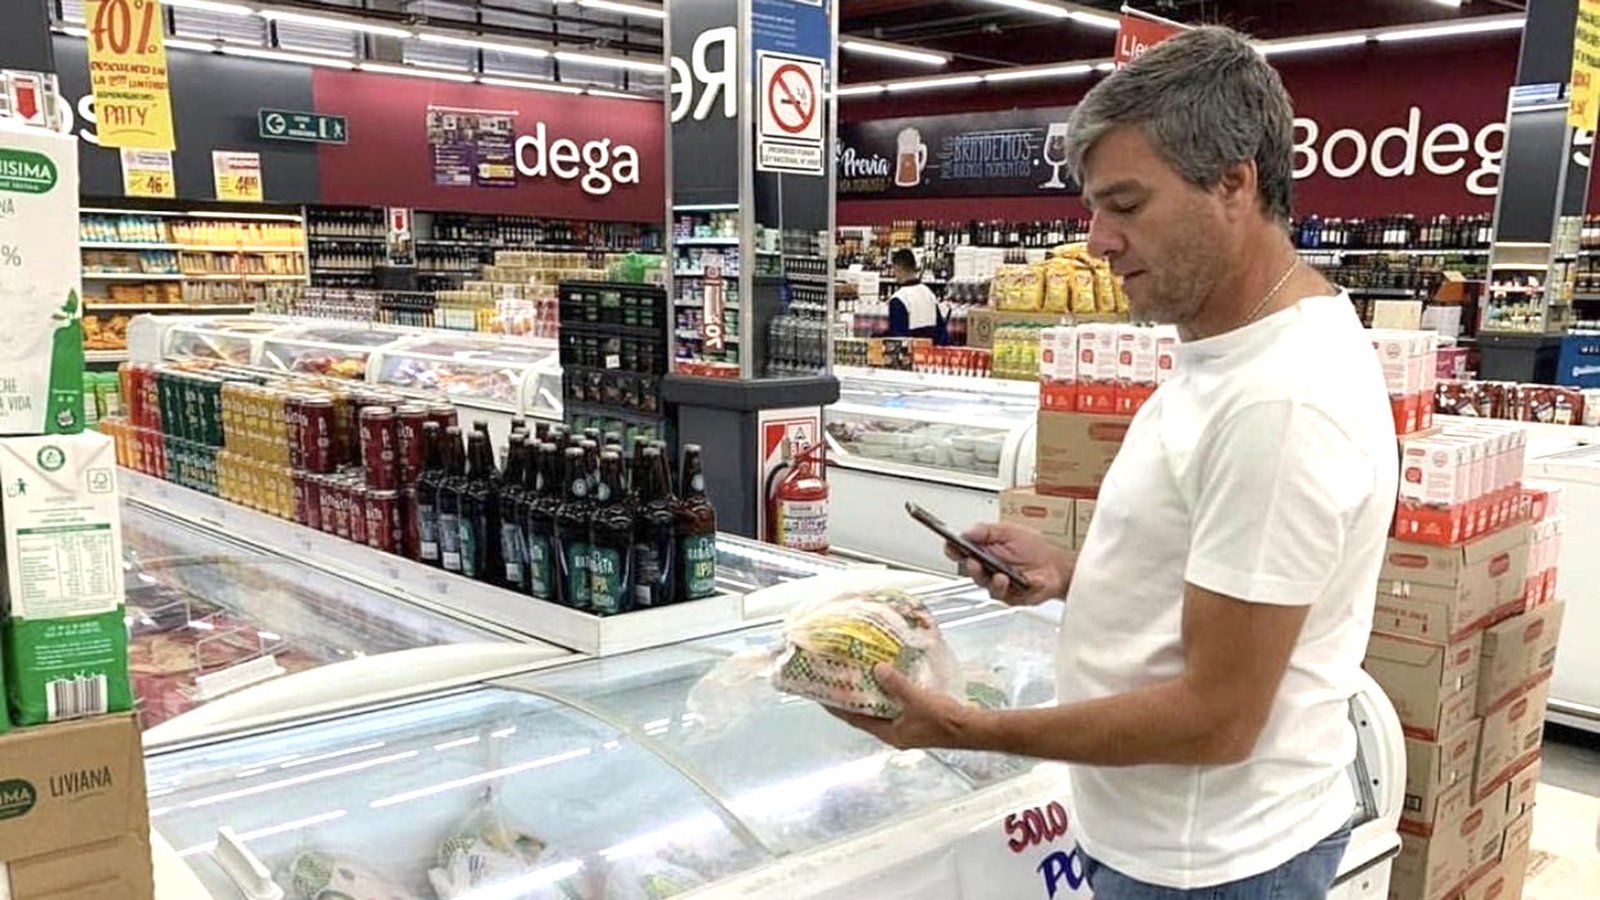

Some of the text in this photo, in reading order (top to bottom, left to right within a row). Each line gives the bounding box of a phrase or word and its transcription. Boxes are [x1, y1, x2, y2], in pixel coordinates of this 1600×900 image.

[1121, 34, 1149, 59] Lle
[104, 103, 148, 126] PATY
[0, 160, 52, 179] ISIMA
[515, 121, 639, 195] dega
[841, 147, 888, 177] Previa
[50, 766, 112, 797] LIVIANA
[1005, 801, 1067, 853] SOLO
